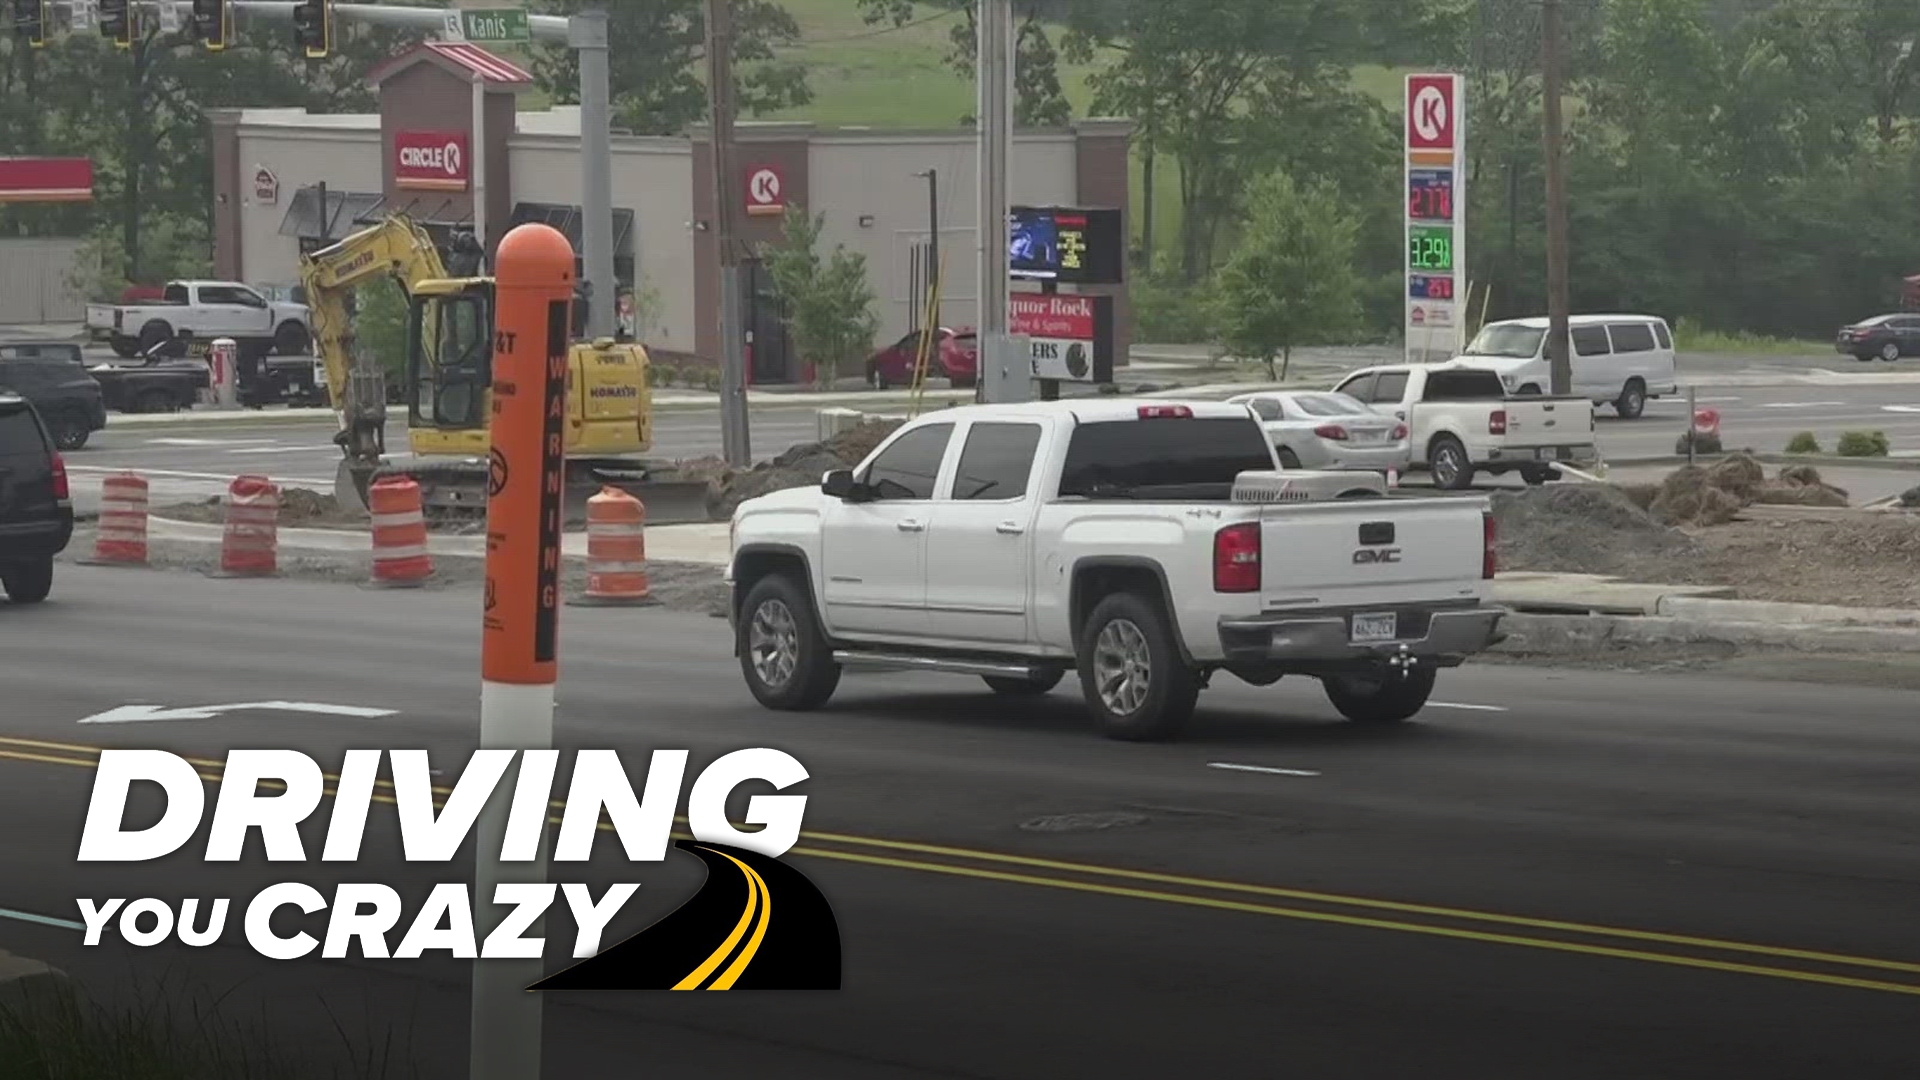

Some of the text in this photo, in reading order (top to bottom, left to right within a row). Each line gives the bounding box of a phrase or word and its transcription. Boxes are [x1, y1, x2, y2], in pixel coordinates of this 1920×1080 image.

[468, 11, 506, 39] Kanis
[400, 144, 460, 174] CIRCLE K
[1010, 298, 1091, 319] quor Rock
[1031, 342, 1058, 359] ERS
[590, 386, 637, 398] KOMATSU
[542, 356, 566, 609] WARNING
[1352, 549, 1401, 563] GMC
